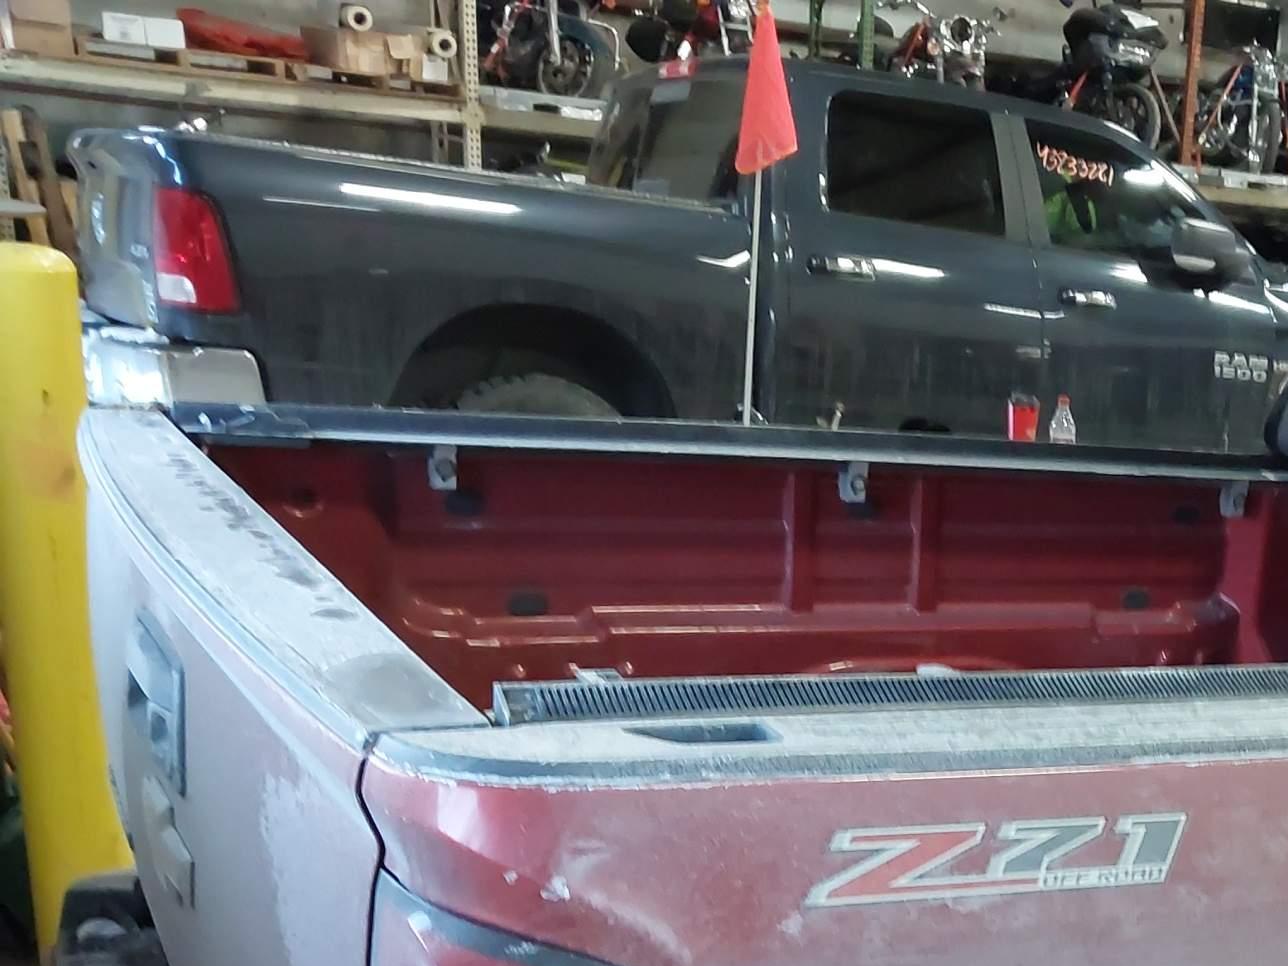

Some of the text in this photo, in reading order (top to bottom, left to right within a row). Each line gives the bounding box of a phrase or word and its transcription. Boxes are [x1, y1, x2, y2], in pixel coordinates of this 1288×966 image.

[1214, 350, 1269, 371] RAM
[1214, 366, 1268, 383] 1500
[805, 811, 1188, 908] Z71
[1043, 869, 1089, 888] OFF
